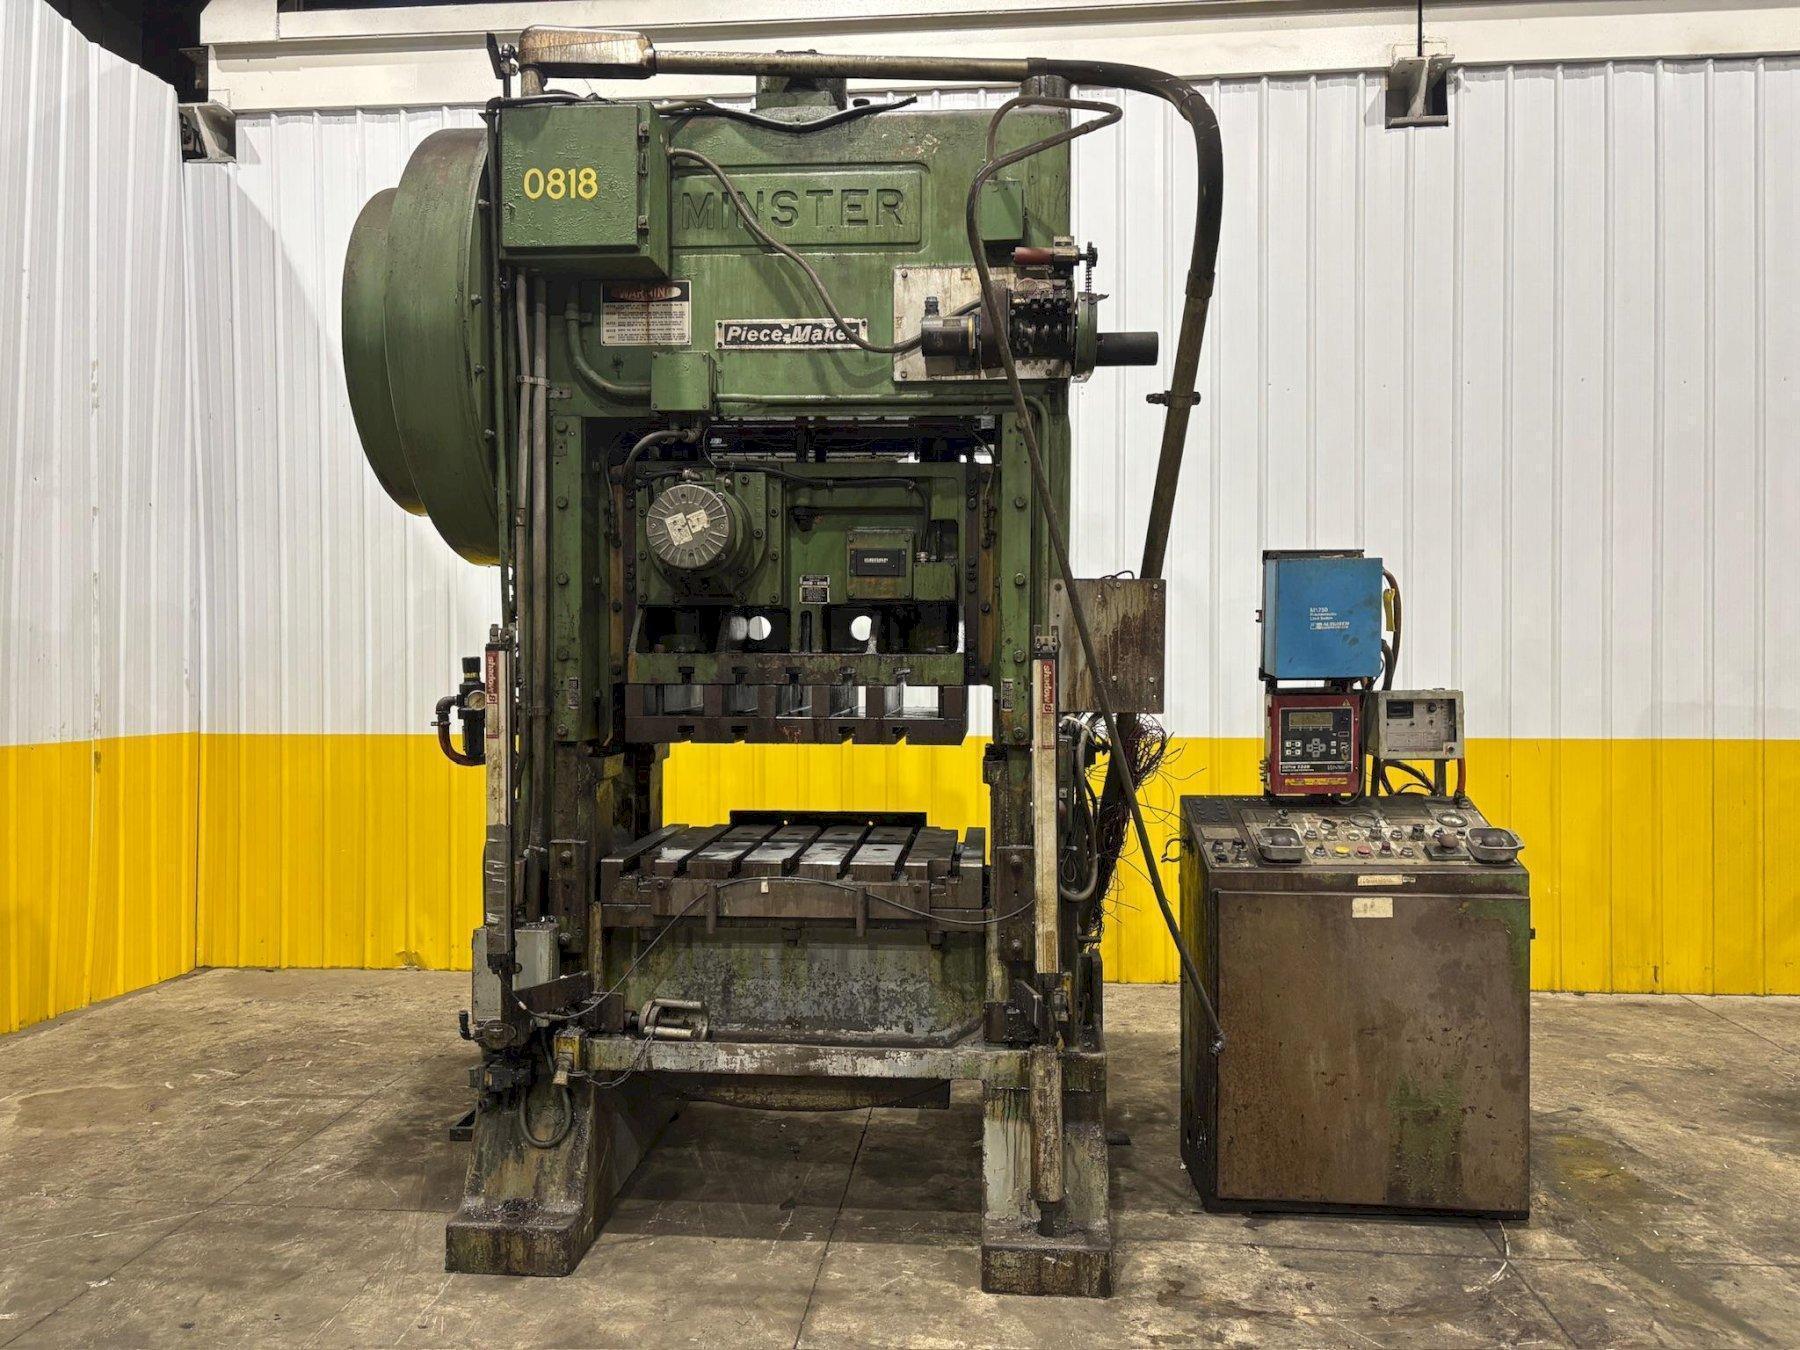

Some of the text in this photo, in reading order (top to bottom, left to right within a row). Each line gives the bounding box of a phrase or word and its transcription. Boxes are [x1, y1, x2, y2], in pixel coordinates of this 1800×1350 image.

[523, 167, 598, 200] 0818
[681, 188, 905, 230] MINSTER
[726, 325, 858, 343] Piece-Make
[488, 656, 496, 693] shadow
[1043, 664, 1052, 704] shadow
